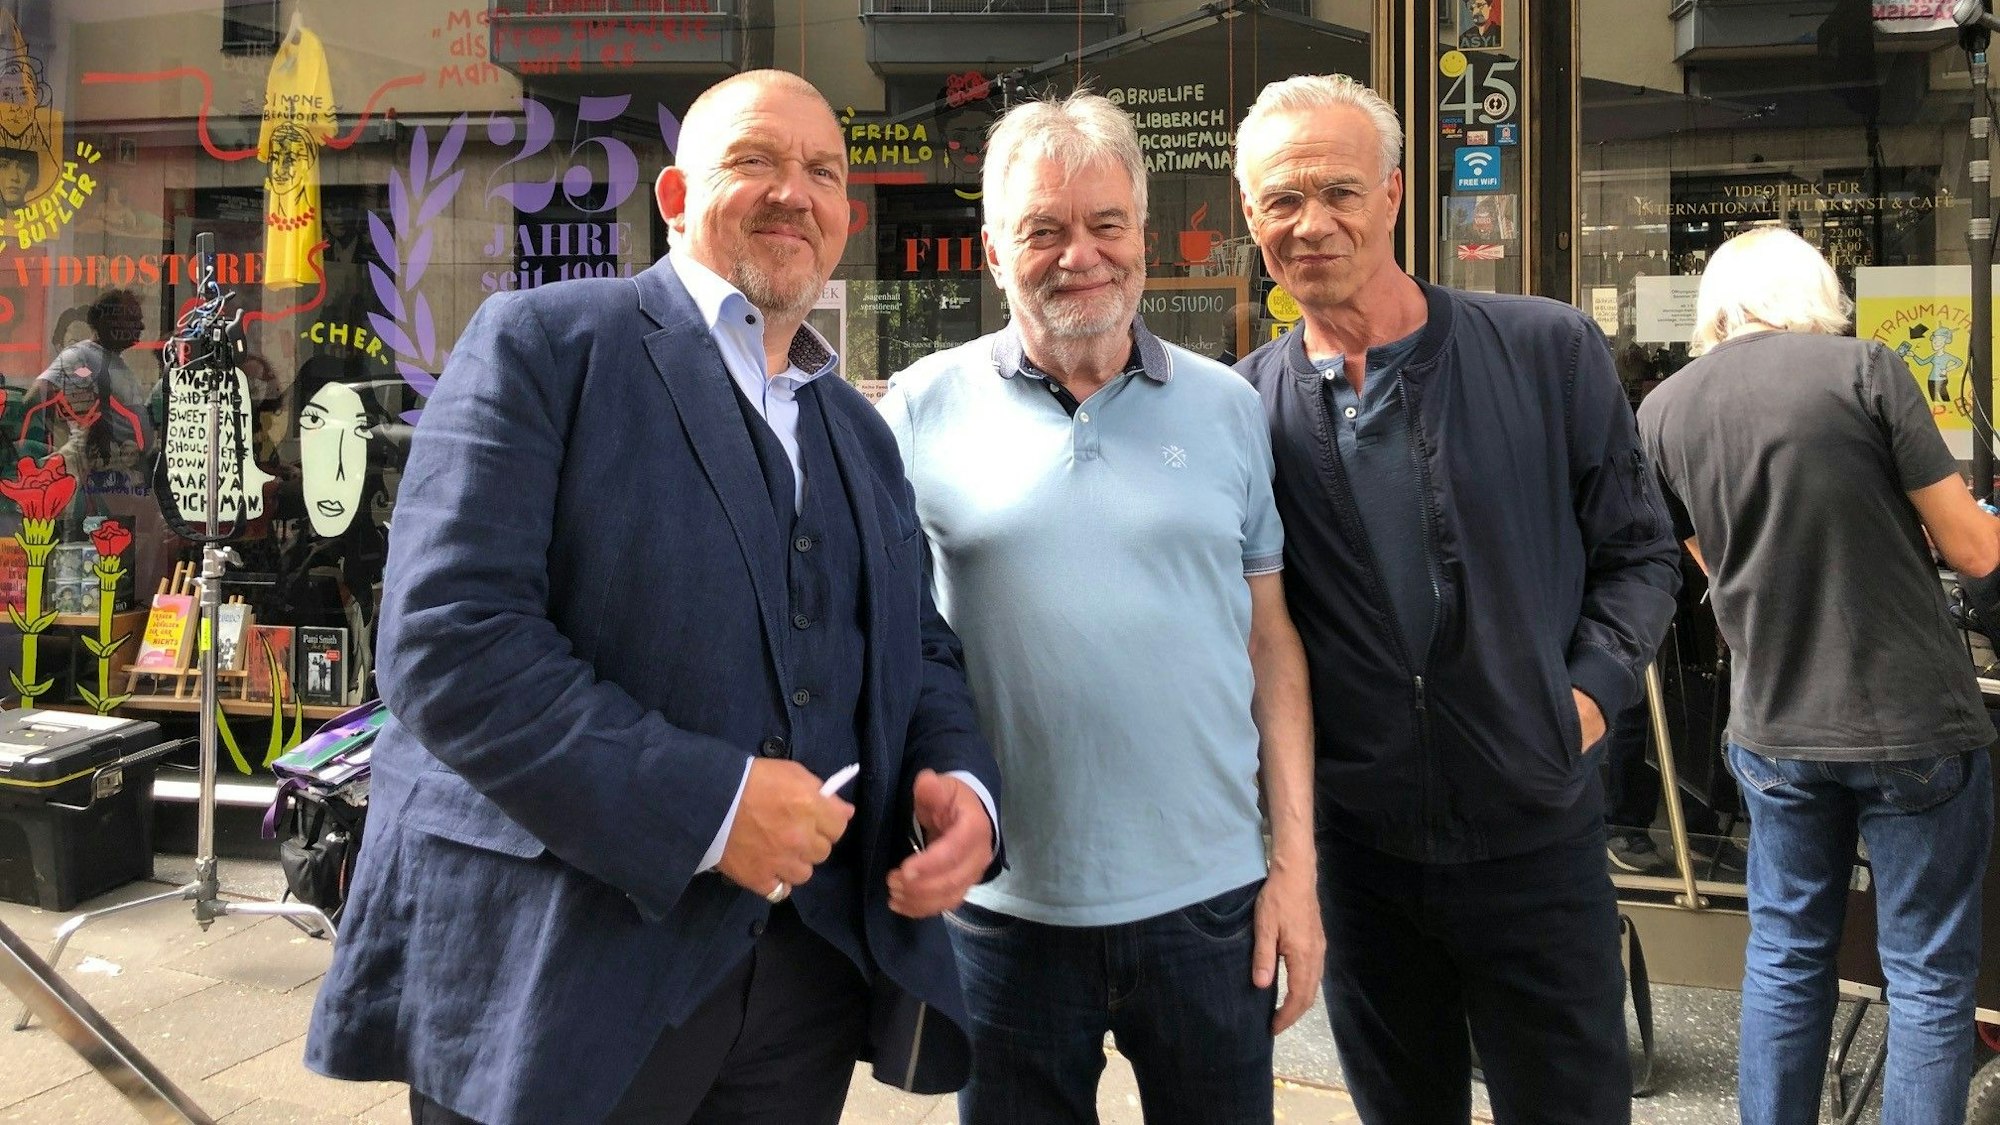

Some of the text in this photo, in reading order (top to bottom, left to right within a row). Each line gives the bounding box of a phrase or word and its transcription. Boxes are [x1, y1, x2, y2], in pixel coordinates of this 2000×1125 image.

[1460, 35, 1499, 48] ASYL
[1106, 83, 1205, 106] @BRUELIFE
[1440, 60, 1519, 125] 45
[1129, 109, 1224, 129] LIBBERICH
[852, 123, 928, 142] FRIDA
[485, 93, 640, 213] 25
[850, 145, 933, 166] KAHLO
[1458, 179, 1479, 187] FREE
[1723, 181, 1860, 198] VIDEOTHEK FÜR
[14, 161, 78, 229] JUDITH
[1891, 197, 1904, 210] &
[18, 173, 97, 250] BUTLER
[483, 222, 634, 258] JAHRE
[1169, 295, 1224, 313] STUDIO
[1872, 303, 1972, 343] TRAUMATH
[168, 457, 206, 470] DOWN
